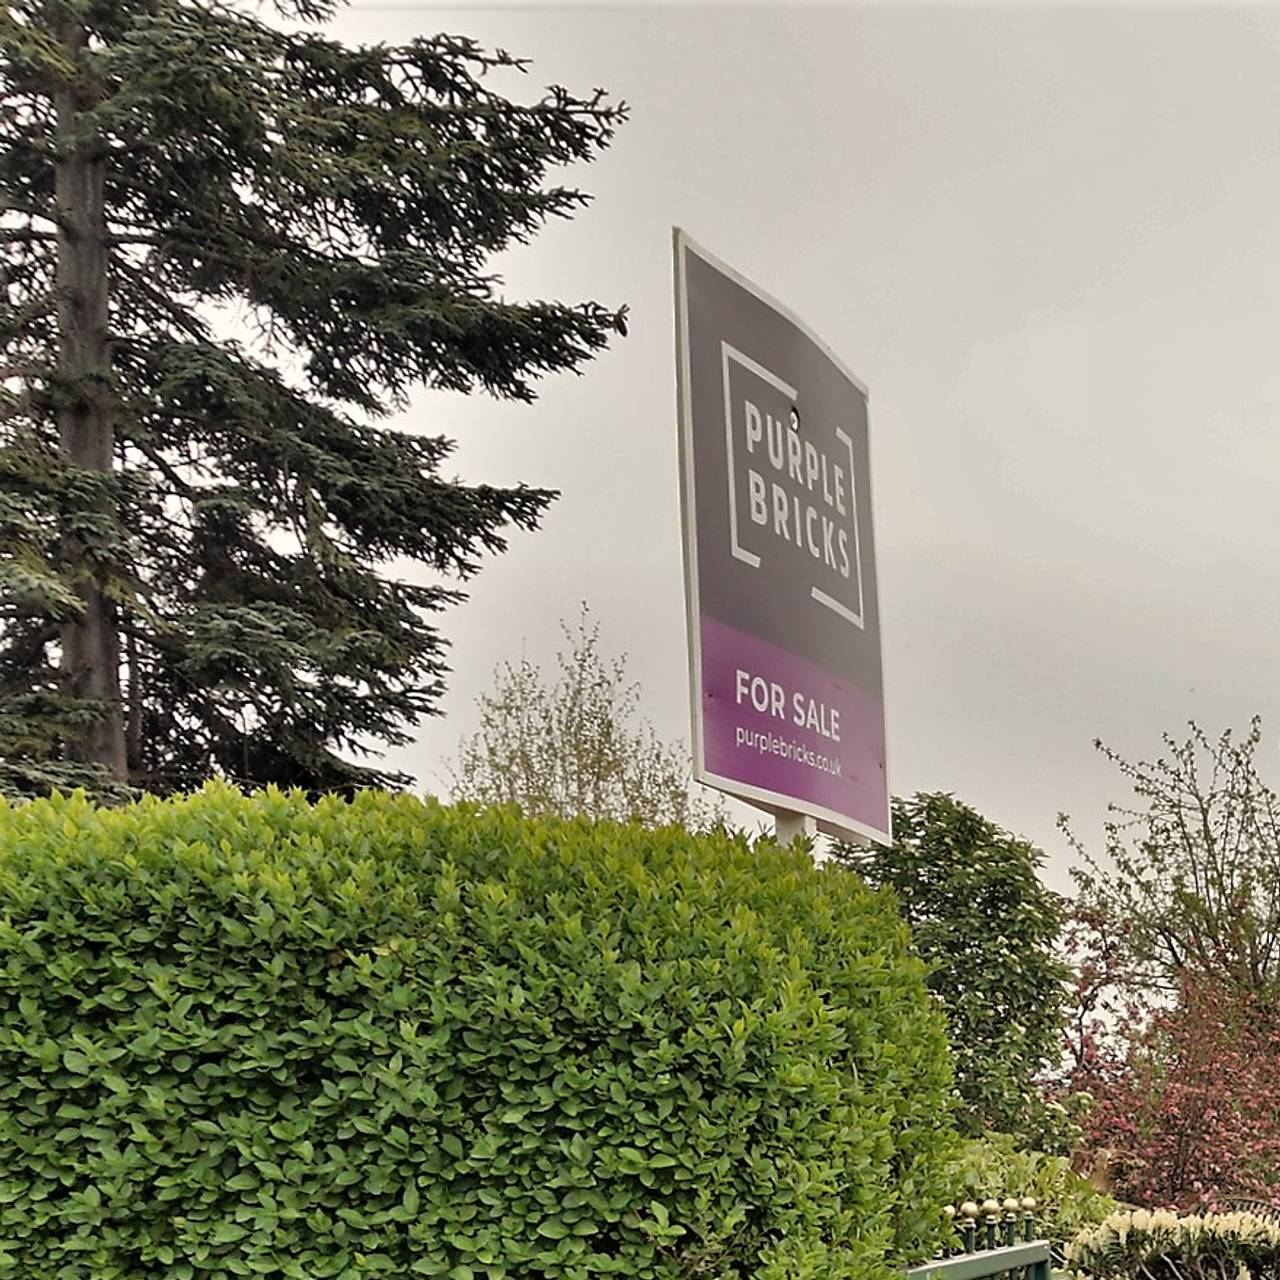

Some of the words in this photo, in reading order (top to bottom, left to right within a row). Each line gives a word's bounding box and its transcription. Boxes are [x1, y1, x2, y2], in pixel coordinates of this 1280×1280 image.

[745, 400, 847, 517] PURPLE
[748, 468, 850, 579] BRICKS
[736, 669, 786, 720] FOR
[793, 692, 841, 742] SALE
[735, 726, 842, 778] purplebricks.co.uk
